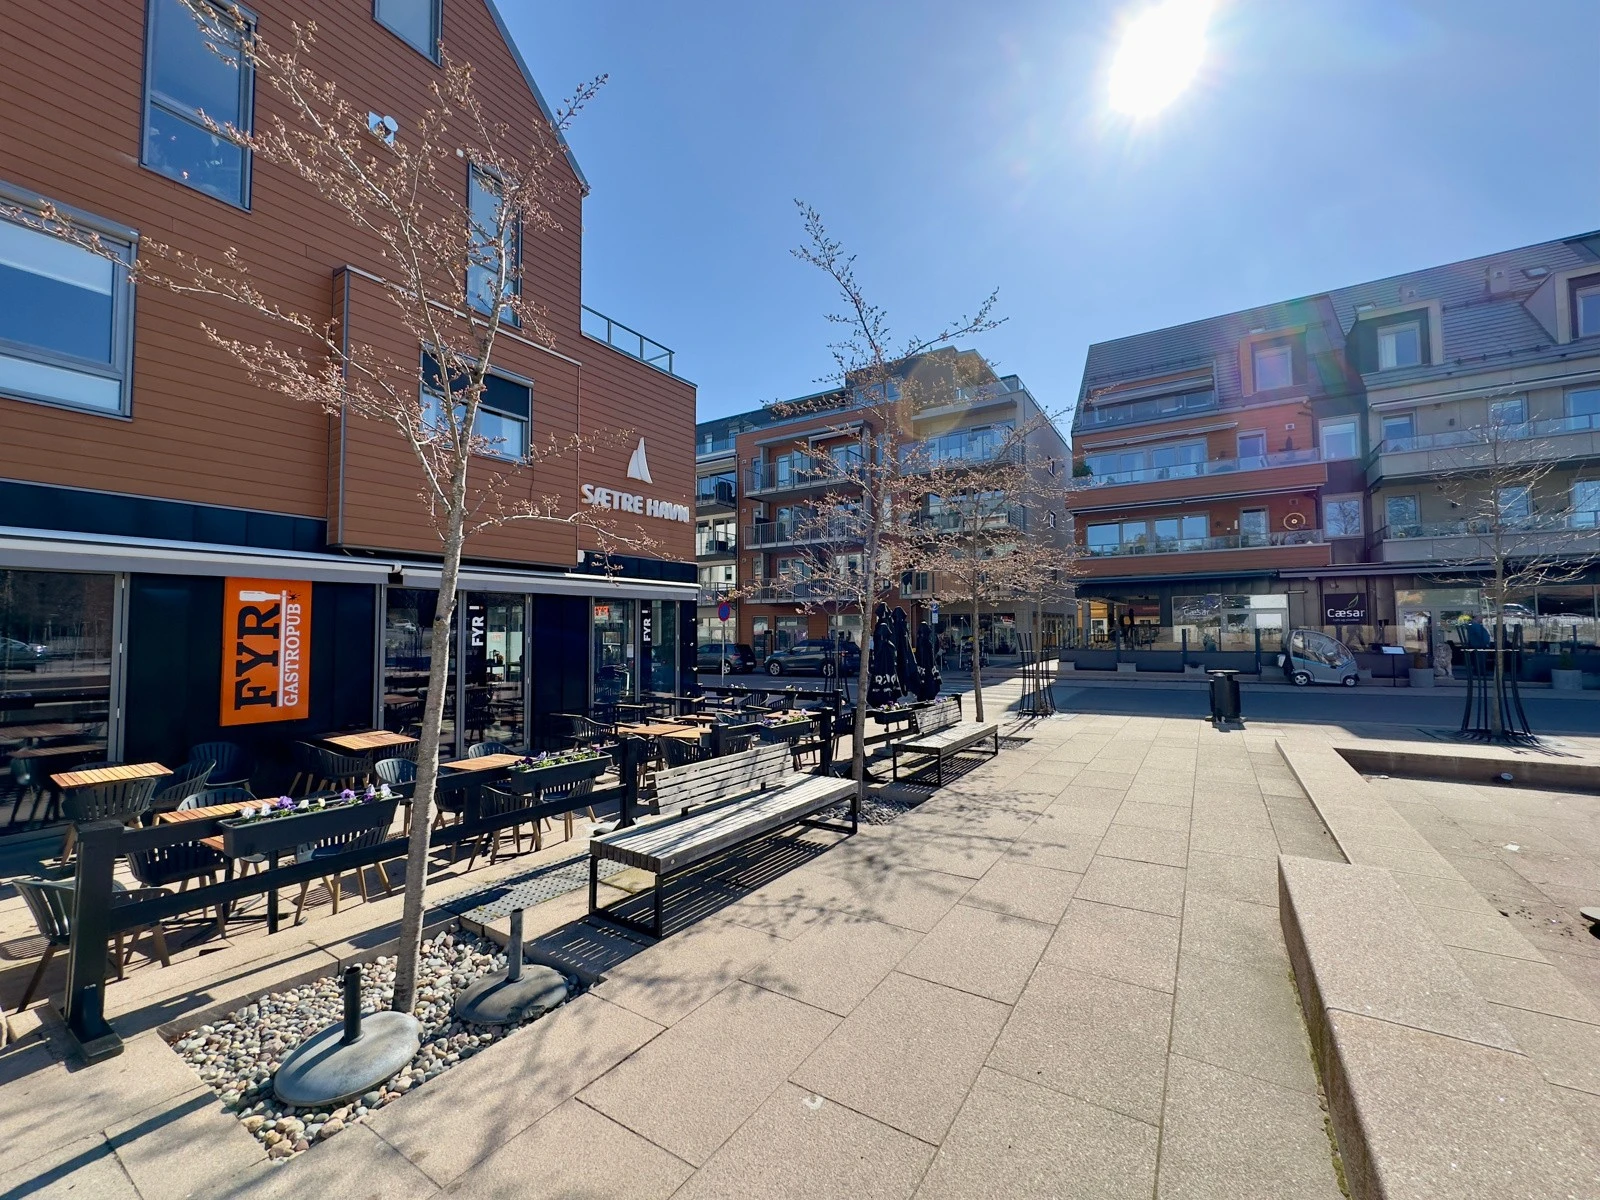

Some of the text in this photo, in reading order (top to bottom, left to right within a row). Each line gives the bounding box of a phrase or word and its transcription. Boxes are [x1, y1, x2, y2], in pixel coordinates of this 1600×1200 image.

[581, 484, 690, 523] SÆTRE HAVN
[643, 618, 652, 642] FYR
[1327, 608, 1365, 618] Cæsar
[471, 616, 485, 647] FYR
[234, 603, 281, 711] FYR
[284, 603, 301, 707] GASTROPUB
